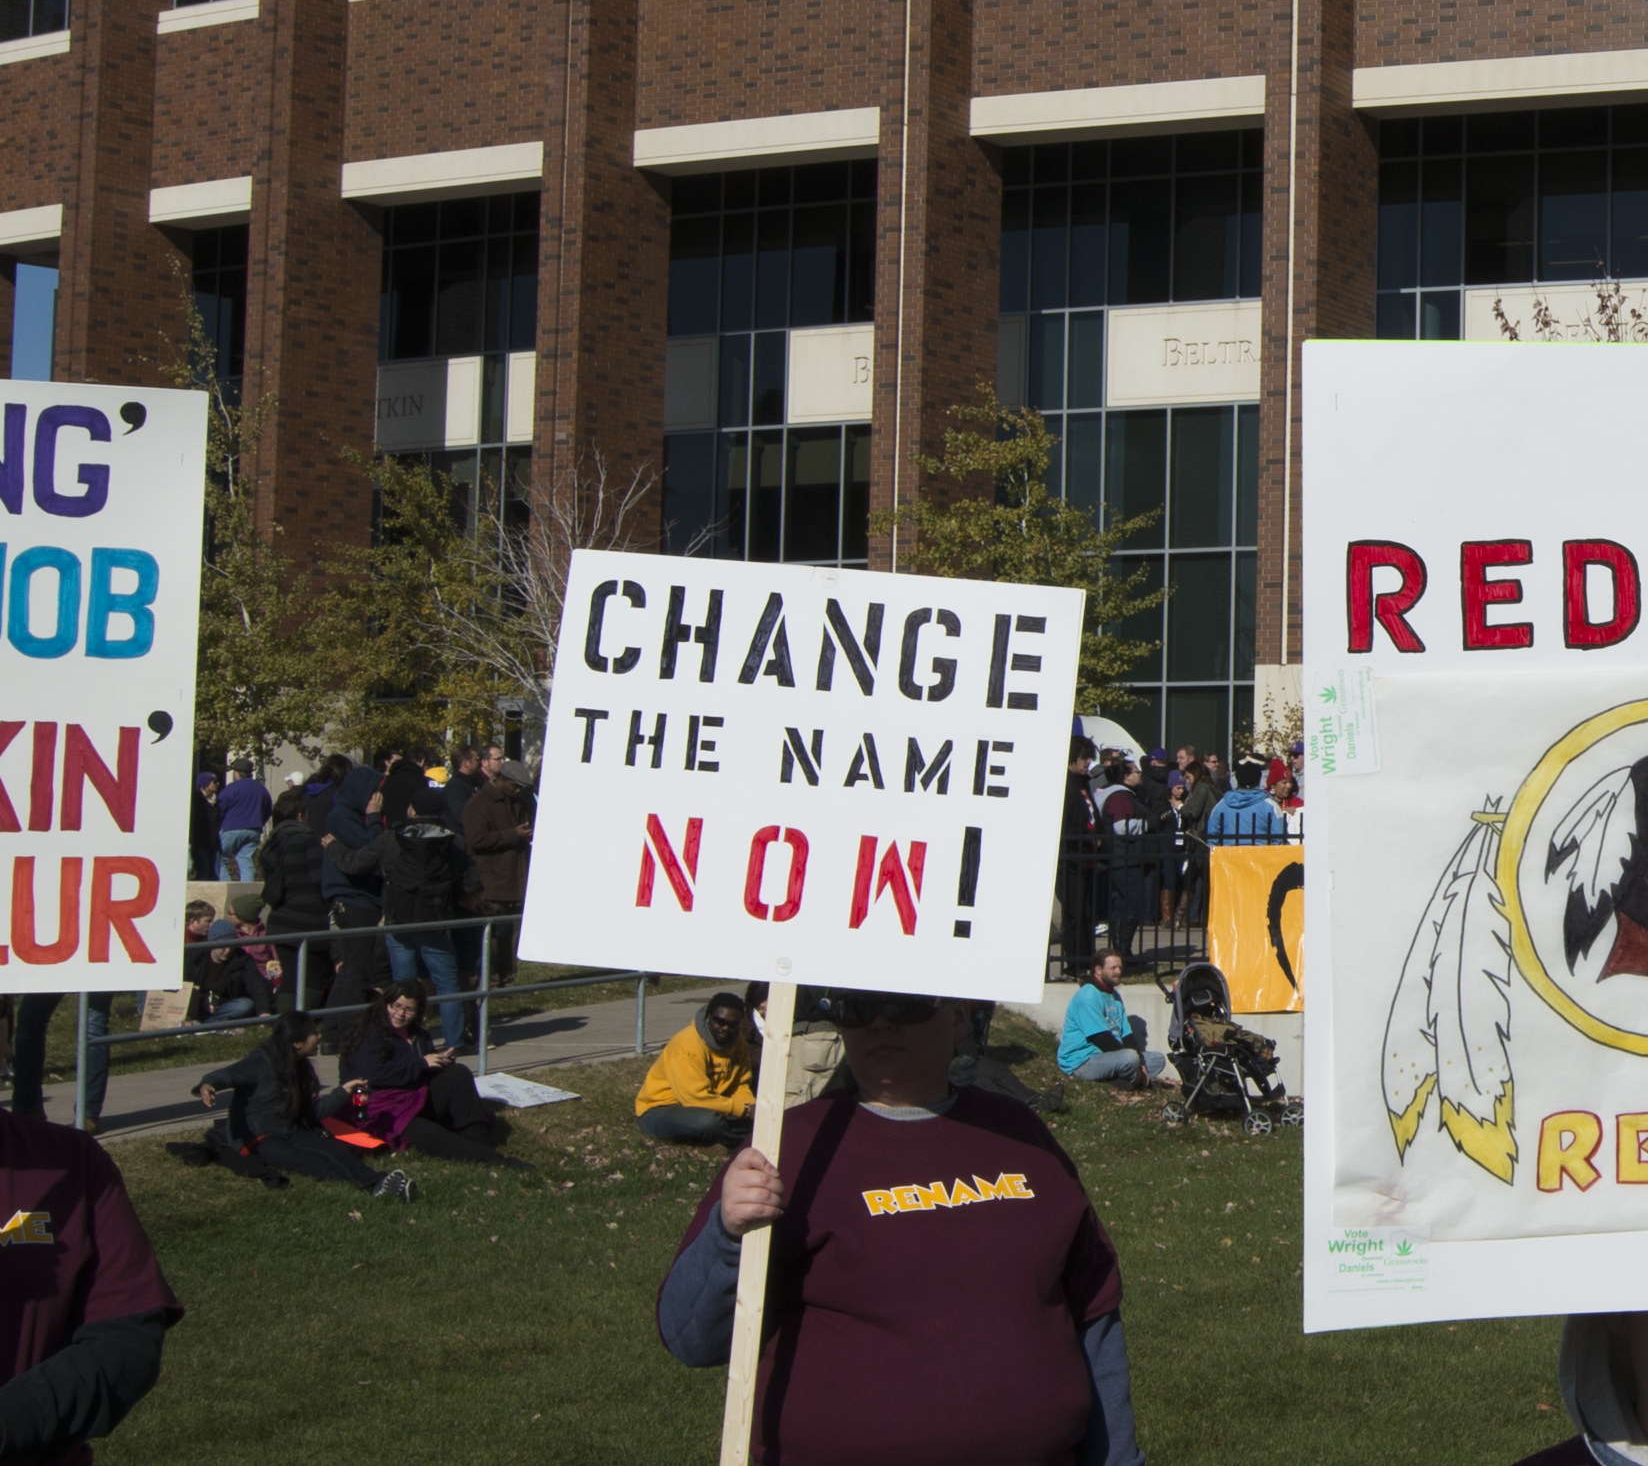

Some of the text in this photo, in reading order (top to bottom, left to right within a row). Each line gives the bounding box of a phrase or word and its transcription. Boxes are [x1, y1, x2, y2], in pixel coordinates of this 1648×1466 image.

[1162, 337, 1262, 369] BELTR
[377, 394, 424, 420] TKIN
[583, 579, 1049, 712] CHANGE
[573, 707, 1015, 799] THE NAME
[1309, 735, 1319, 761] Vote
[1318, 716, 1338, 776] Wright
[1345, 722, 1356, 760] Daniels
[635, 812, 982, 939] NOW!
[862, 1171, 1035, 1217] RENAME
[1328, 1238, 1384, 1256] Wright
[1344, 1229, 1369, 1239] Vote
[1338, 1262, 1374, 1273] Daniels
